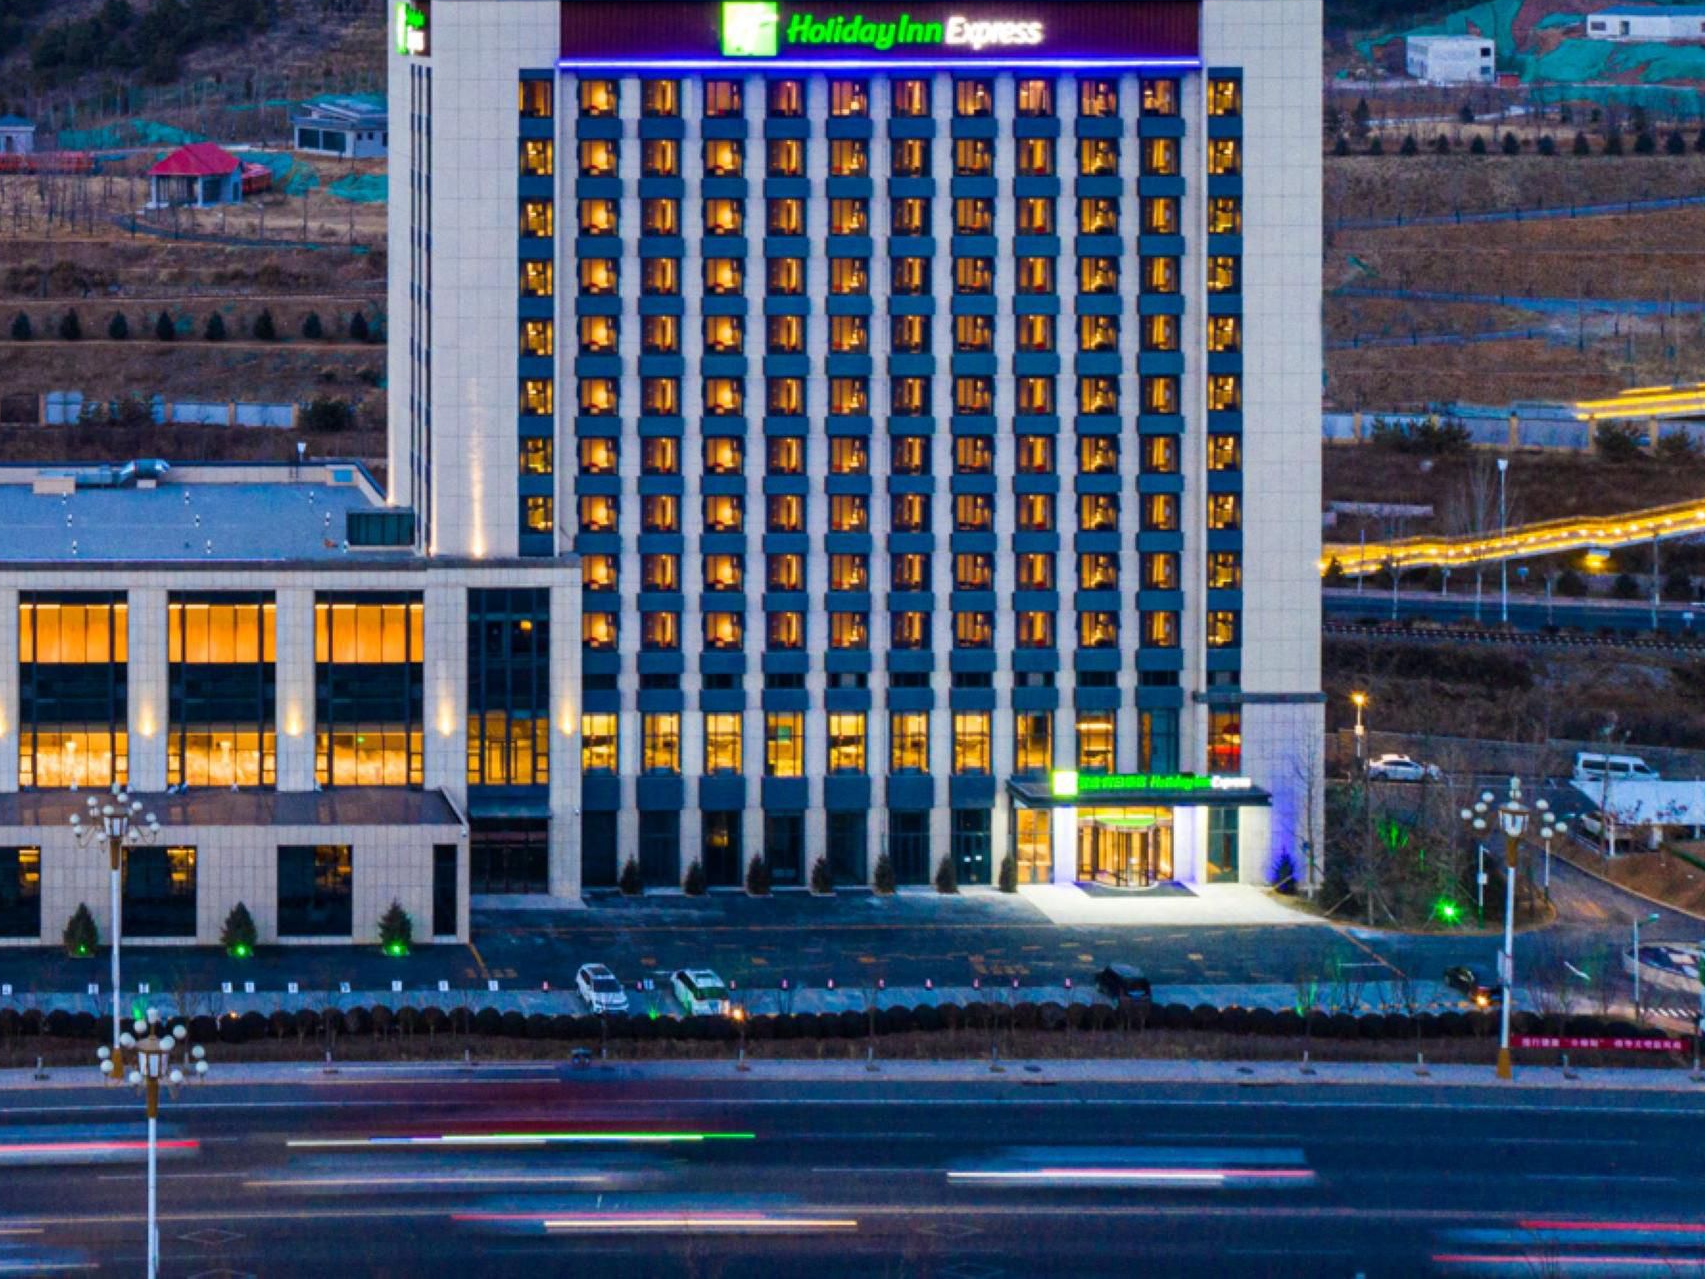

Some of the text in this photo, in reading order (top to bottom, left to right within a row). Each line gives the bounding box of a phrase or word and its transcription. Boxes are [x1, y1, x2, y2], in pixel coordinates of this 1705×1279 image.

[787, 13, 1043, 50] Holiday Inn Express
